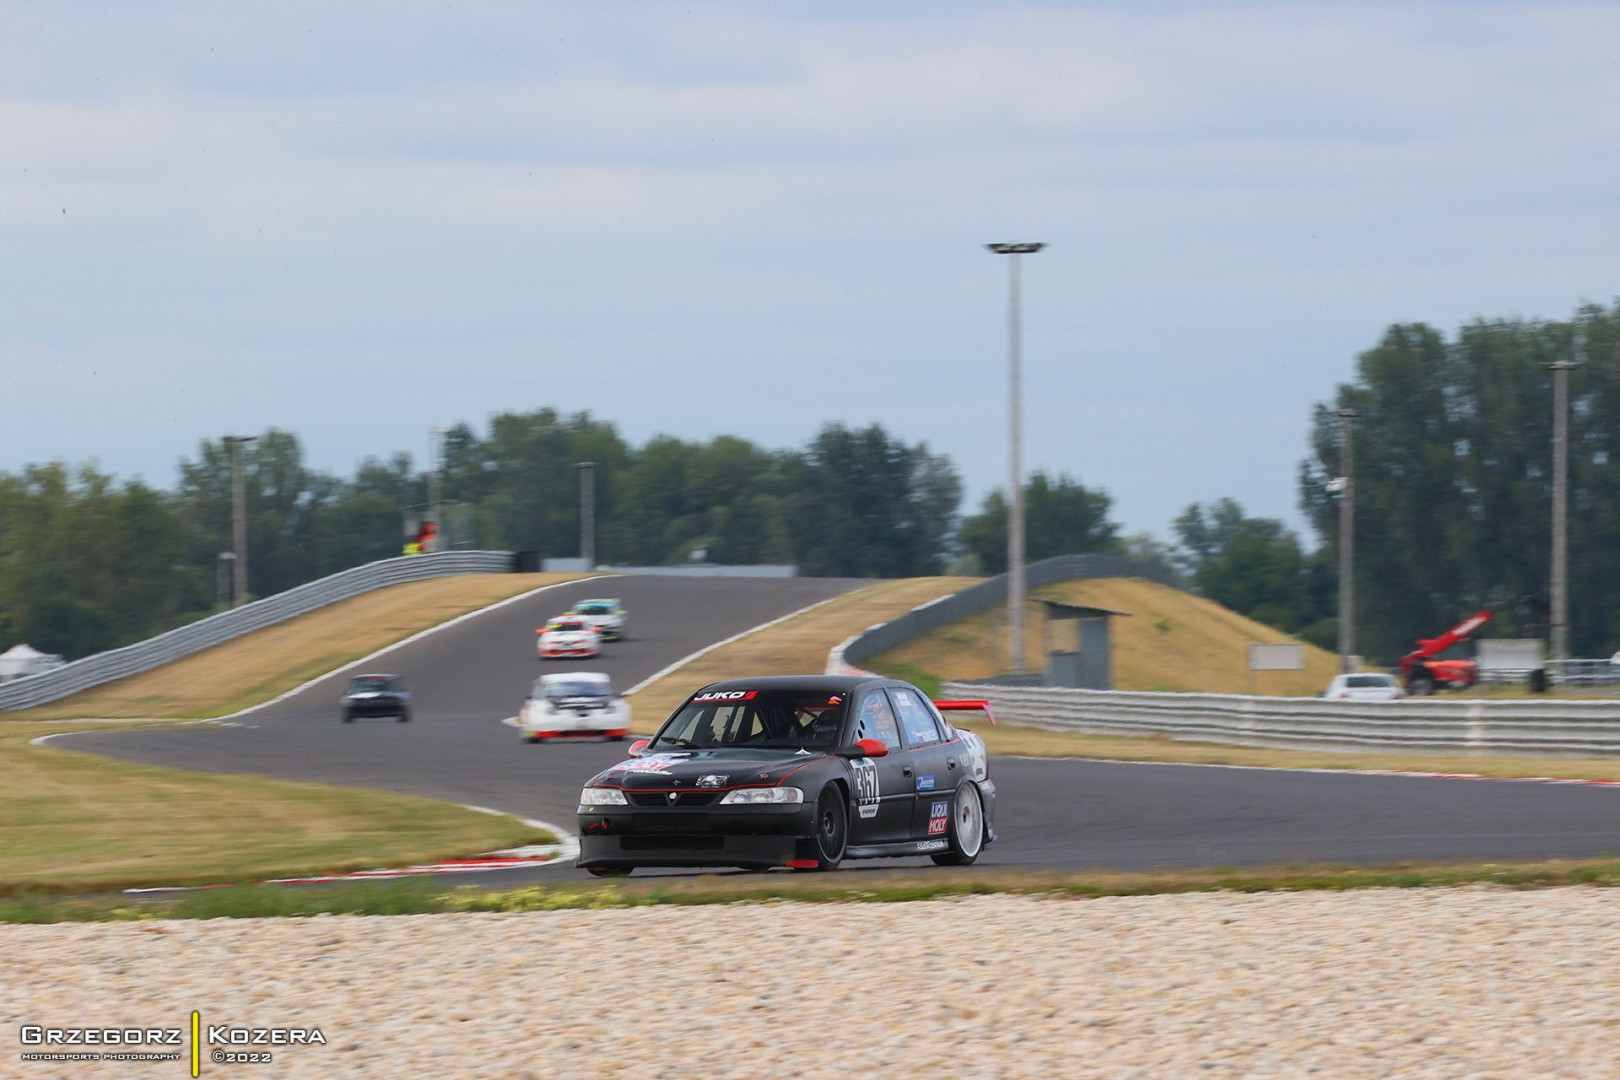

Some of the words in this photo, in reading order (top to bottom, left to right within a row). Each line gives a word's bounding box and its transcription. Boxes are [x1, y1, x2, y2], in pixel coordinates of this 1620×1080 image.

[855, 765, 877, 805] 367
[931, 804, 947, 818] LIQUI
[929, 818, 947, 833] MOLY
